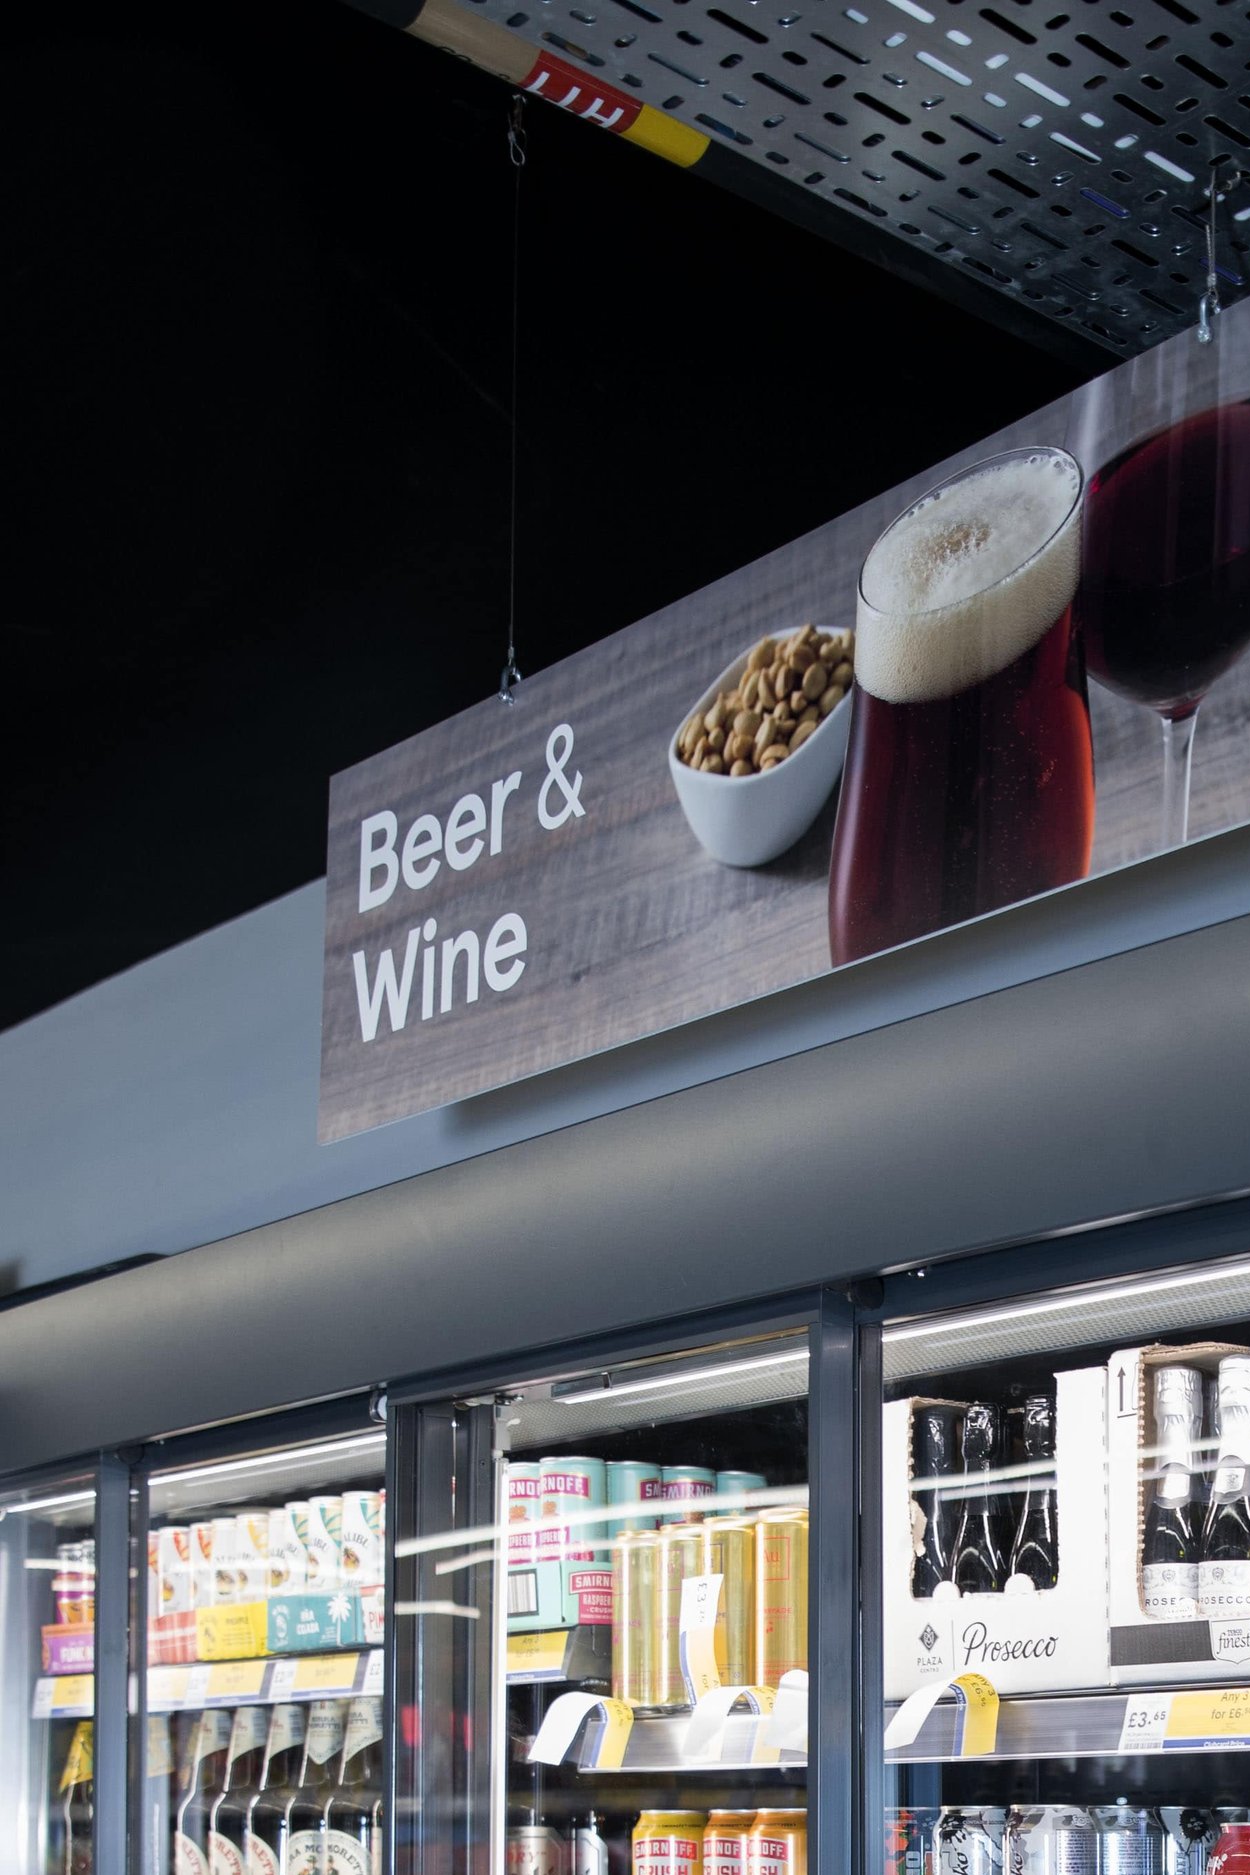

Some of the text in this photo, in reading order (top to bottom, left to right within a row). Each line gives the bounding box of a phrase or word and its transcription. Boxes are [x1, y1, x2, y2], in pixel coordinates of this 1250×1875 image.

[358, 723, 587, 914] Beer &
[352, 911, 528, 1043] Wine
[962, 1621, 1060, 1667] Prosecco
[1216, 1631, 1250, 1655] finest
[916, 1656, 944, 1667] PLAZA
[1220, 1689, 1250, 1703] Any 3
[1127, 1710, 1167, 1730] £3.65
[1210, 1707, 1227, 1721] for
